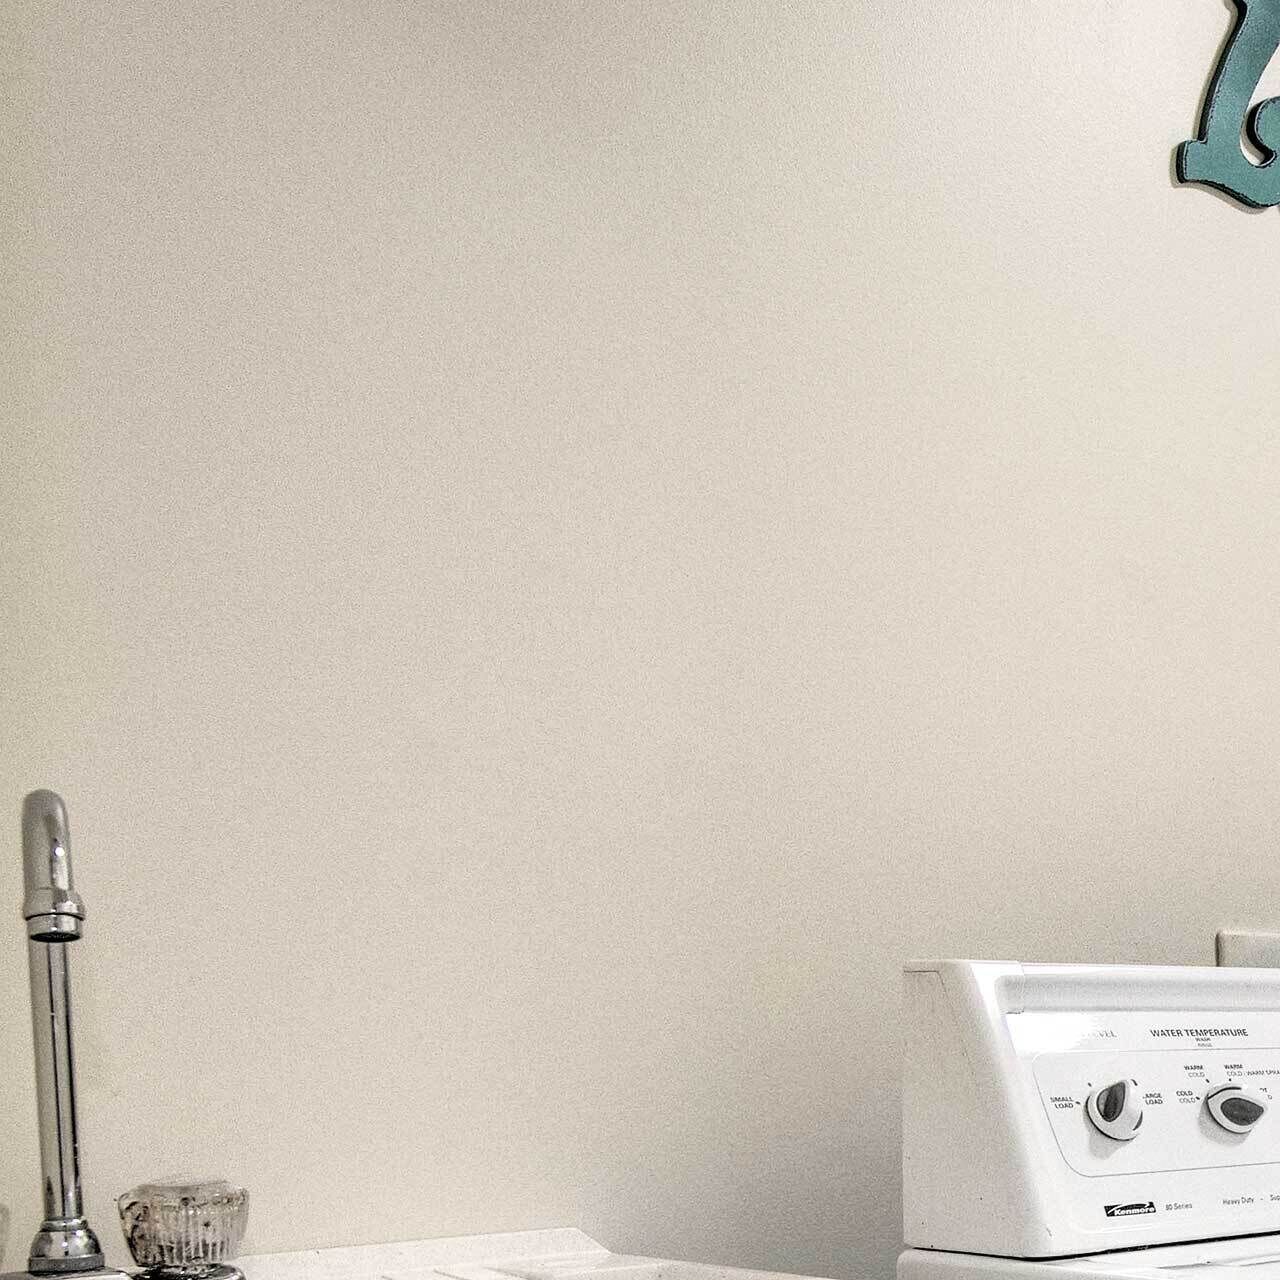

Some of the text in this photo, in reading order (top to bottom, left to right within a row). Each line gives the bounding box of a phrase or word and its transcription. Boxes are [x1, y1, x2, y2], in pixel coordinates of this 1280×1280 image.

[1150, 1028, 1249, 1037] WATER TEMPERATURE
[1222, 1197, 1240, 1206] Heavy
[1240, 1196, 1255, 1205] Duty
[1113, 1204, 1156, 1216] Kenmore
[1173, 1202, 1193, 1211] Series
